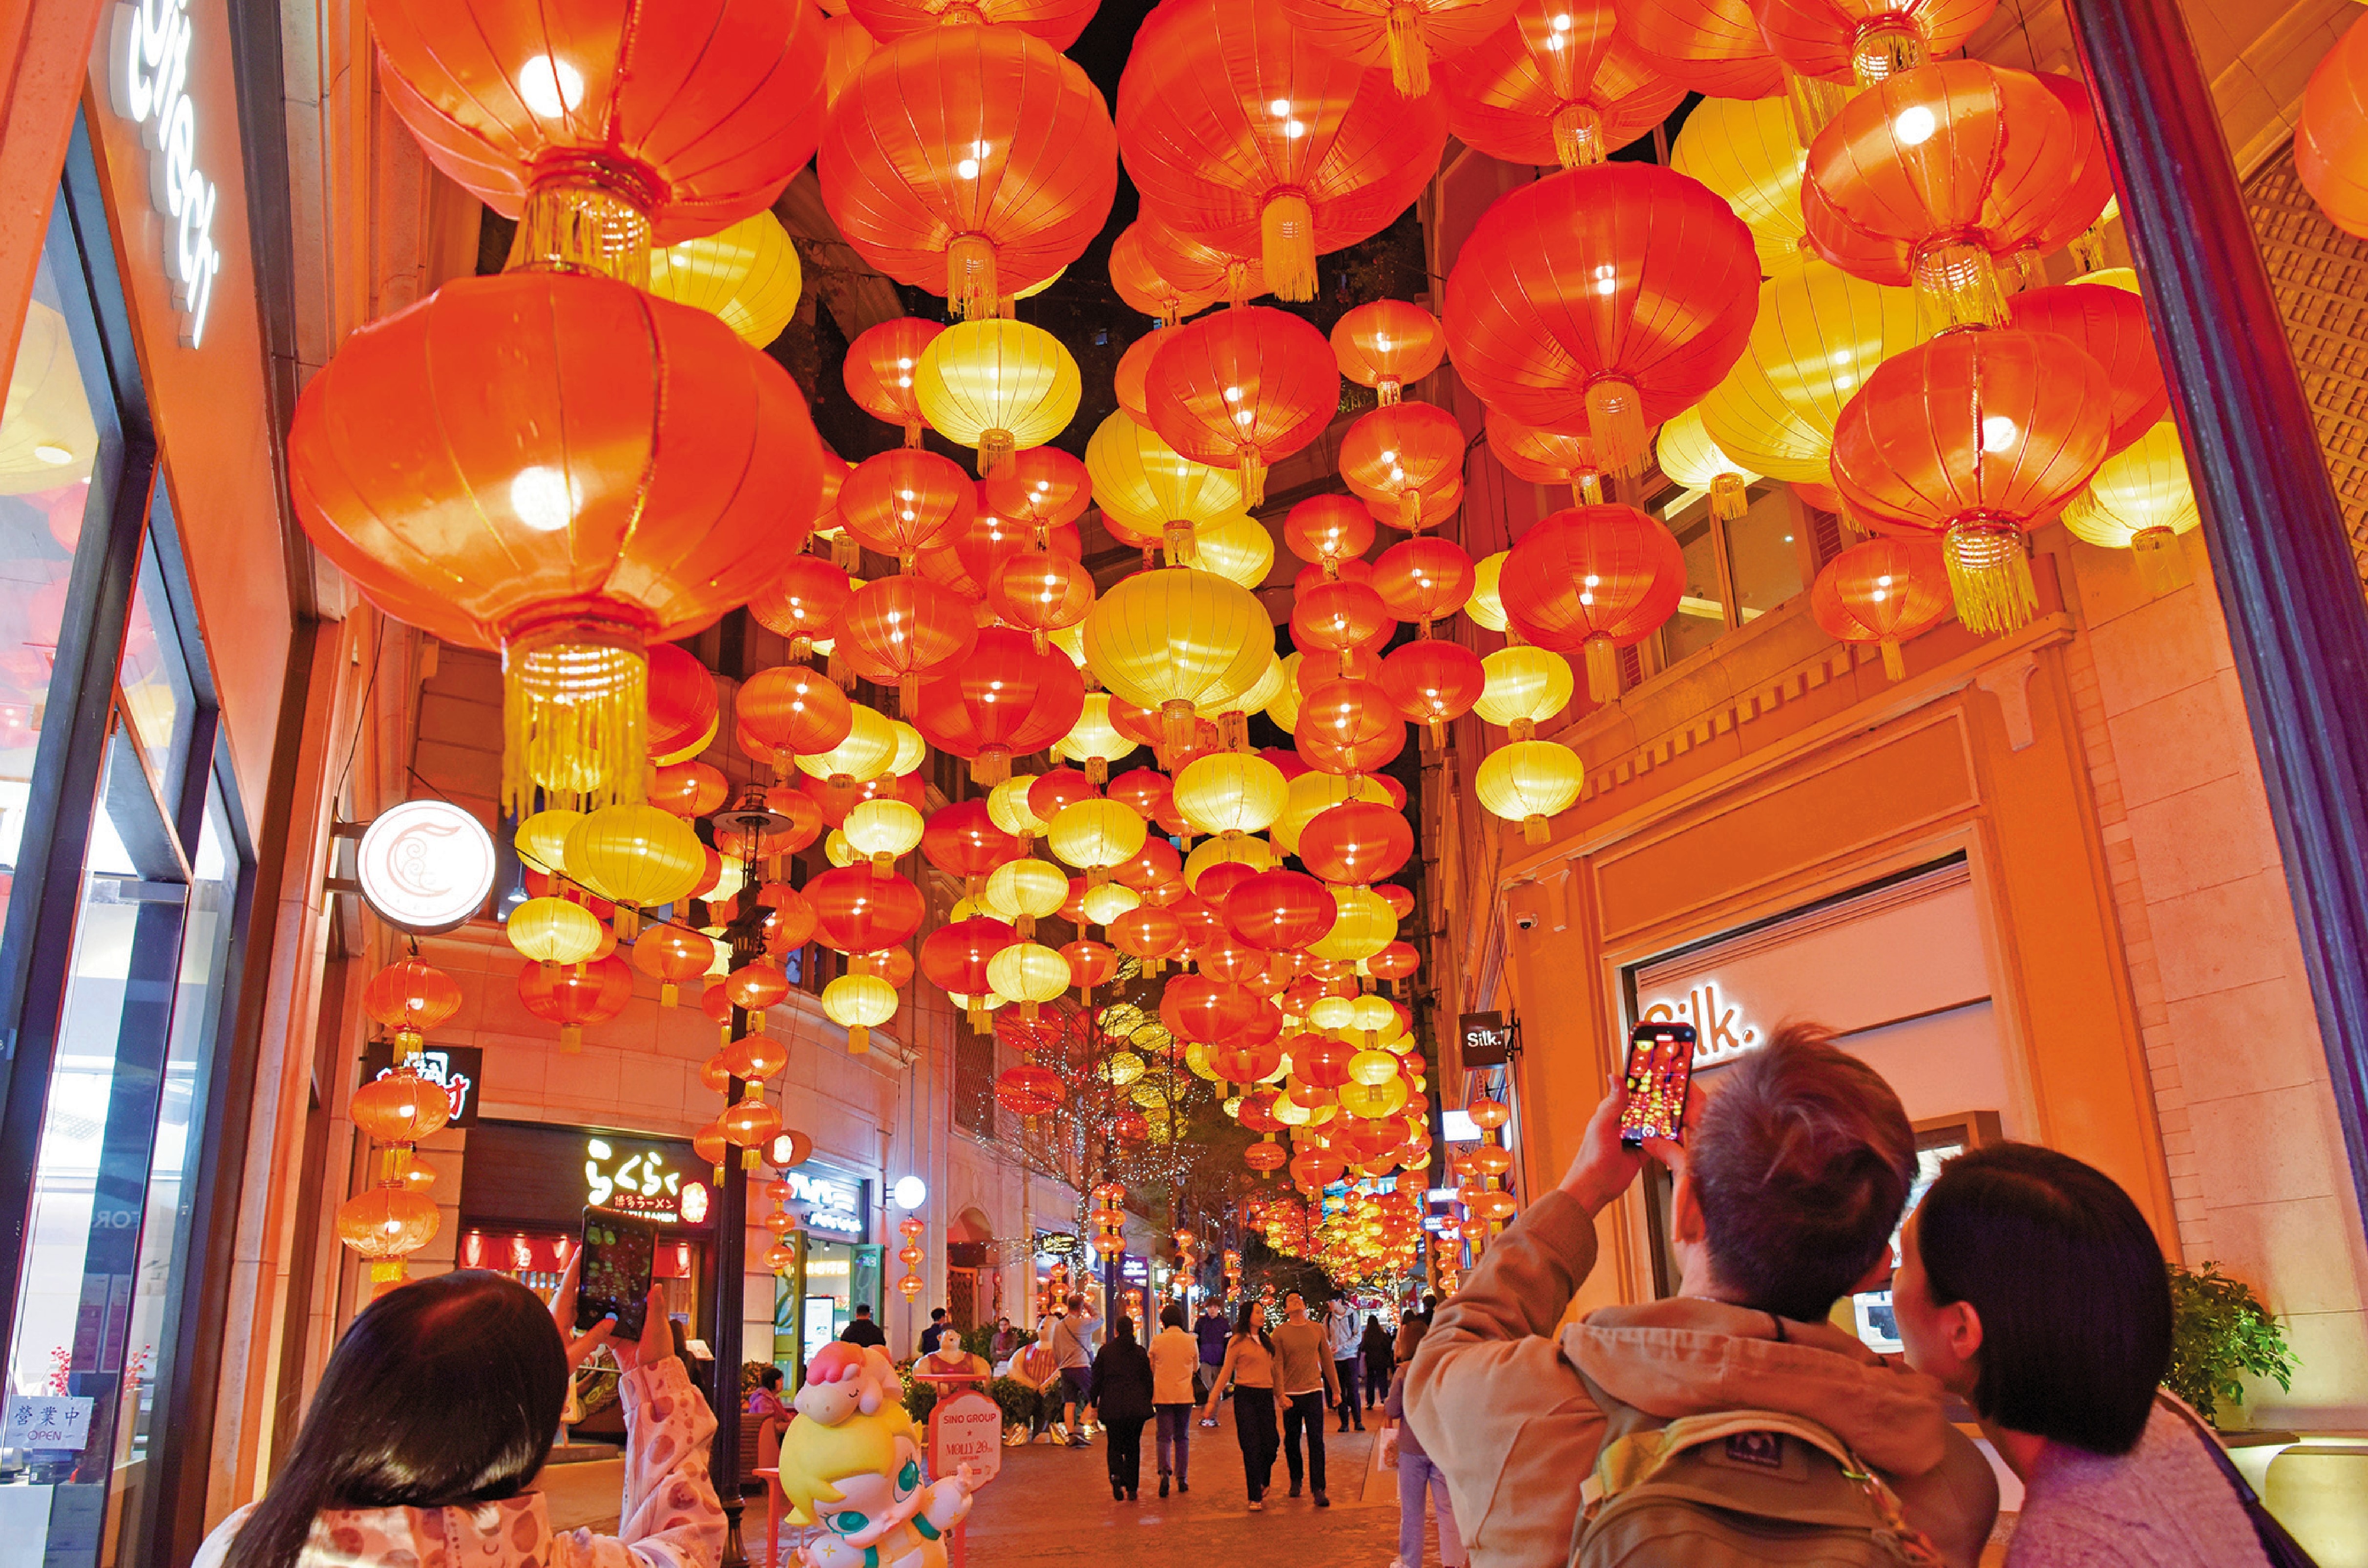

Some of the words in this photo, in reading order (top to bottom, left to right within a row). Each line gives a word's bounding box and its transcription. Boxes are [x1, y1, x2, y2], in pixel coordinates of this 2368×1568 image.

[1644, 986, 1754, 1056] lk.
[1467, 1030, 1502, 1047] Silk.
[586, 1139, 680, 1205] らくらく
[15, 1405, 80, 1426] 營業中
[943, 1415, 964, 1424] SINO
[966, 1413, 996, 1423] GROUP
[28, 1430, 62, 1441] OPEN
